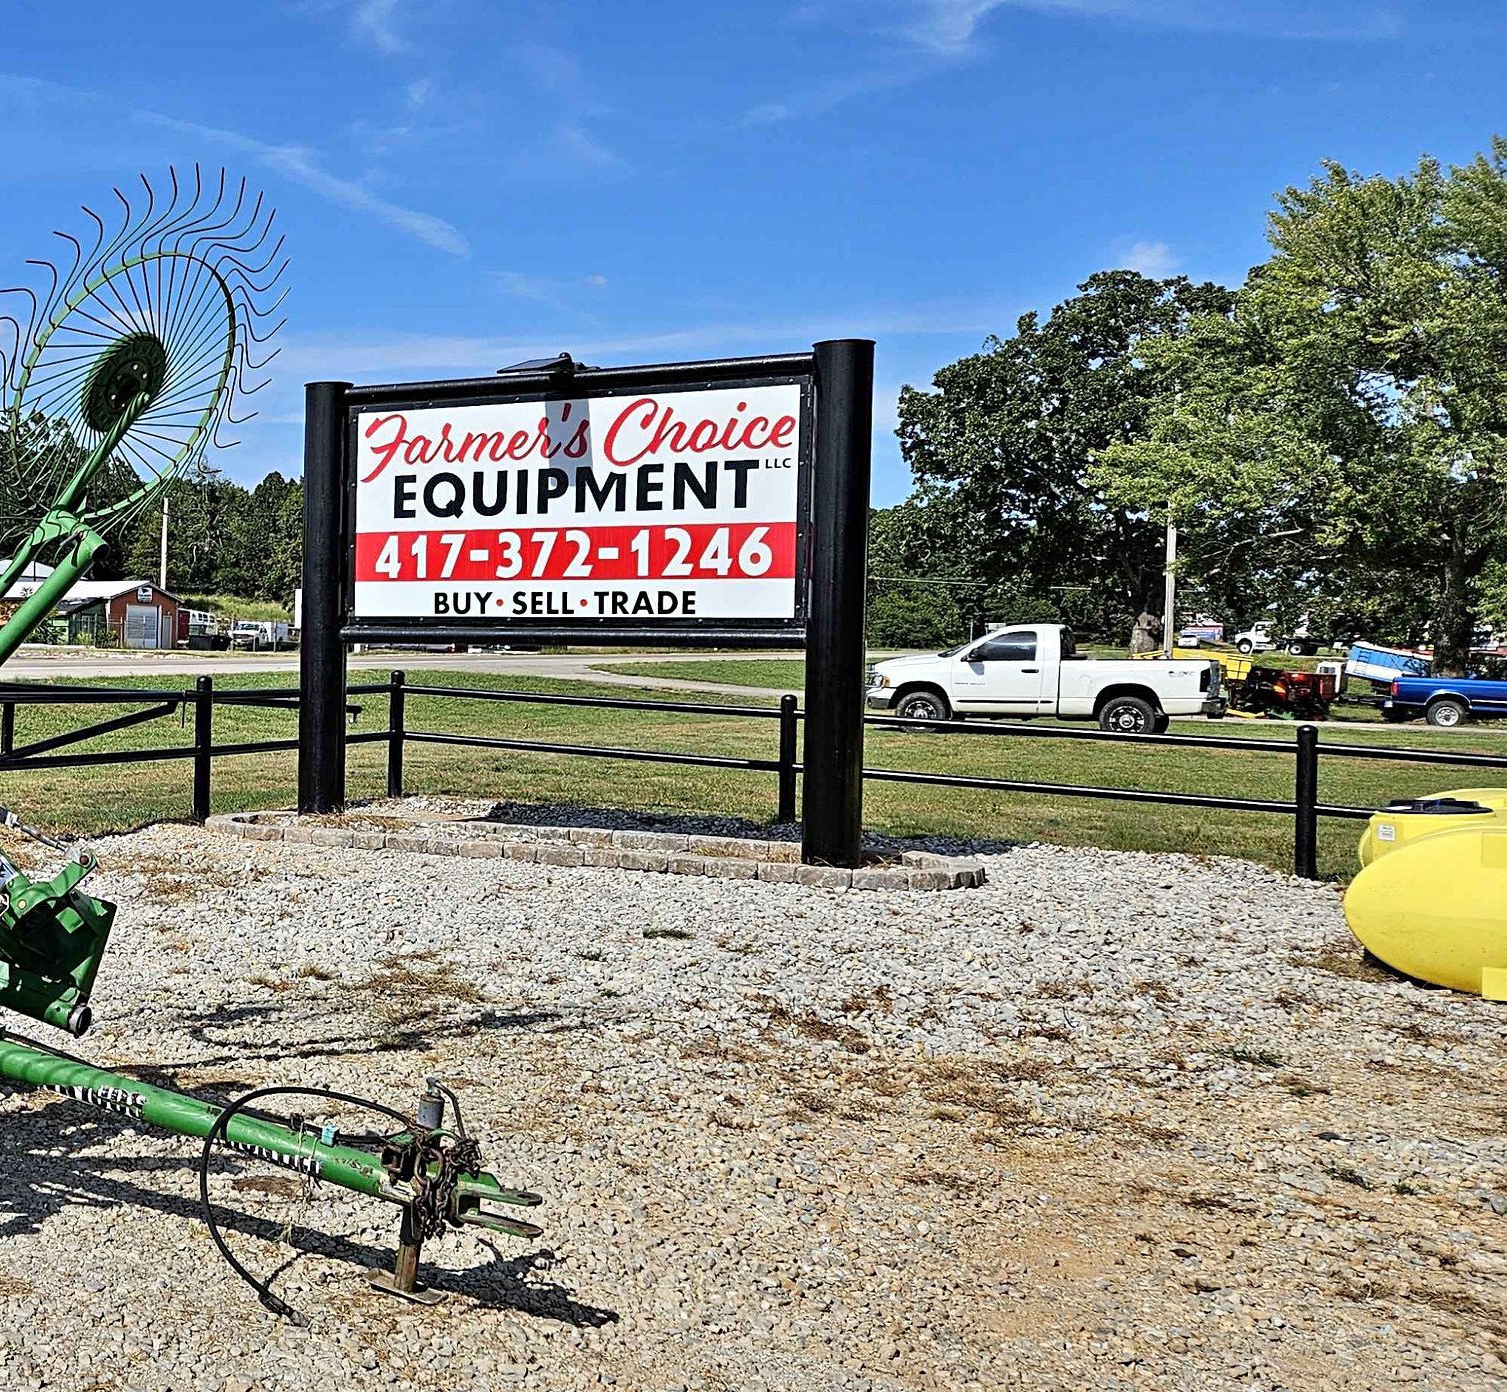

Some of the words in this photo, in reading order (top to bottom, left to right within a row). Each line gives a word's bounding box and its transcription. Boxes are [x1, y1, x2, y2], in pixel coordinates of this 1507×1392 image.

[360, 402, 591, 483] Farmer's
[603, 397, 797, 467] Choice
[393, 458, 759, 519] EQUIPMENT
[765, 457, 792, 469] LLC
[374, 526, 773, 579] 417-372-1246
[434, 591, 492, 615] BUY
[512, 590, 575, 615] SELL
[594, 590, 696, 615] TRADE
